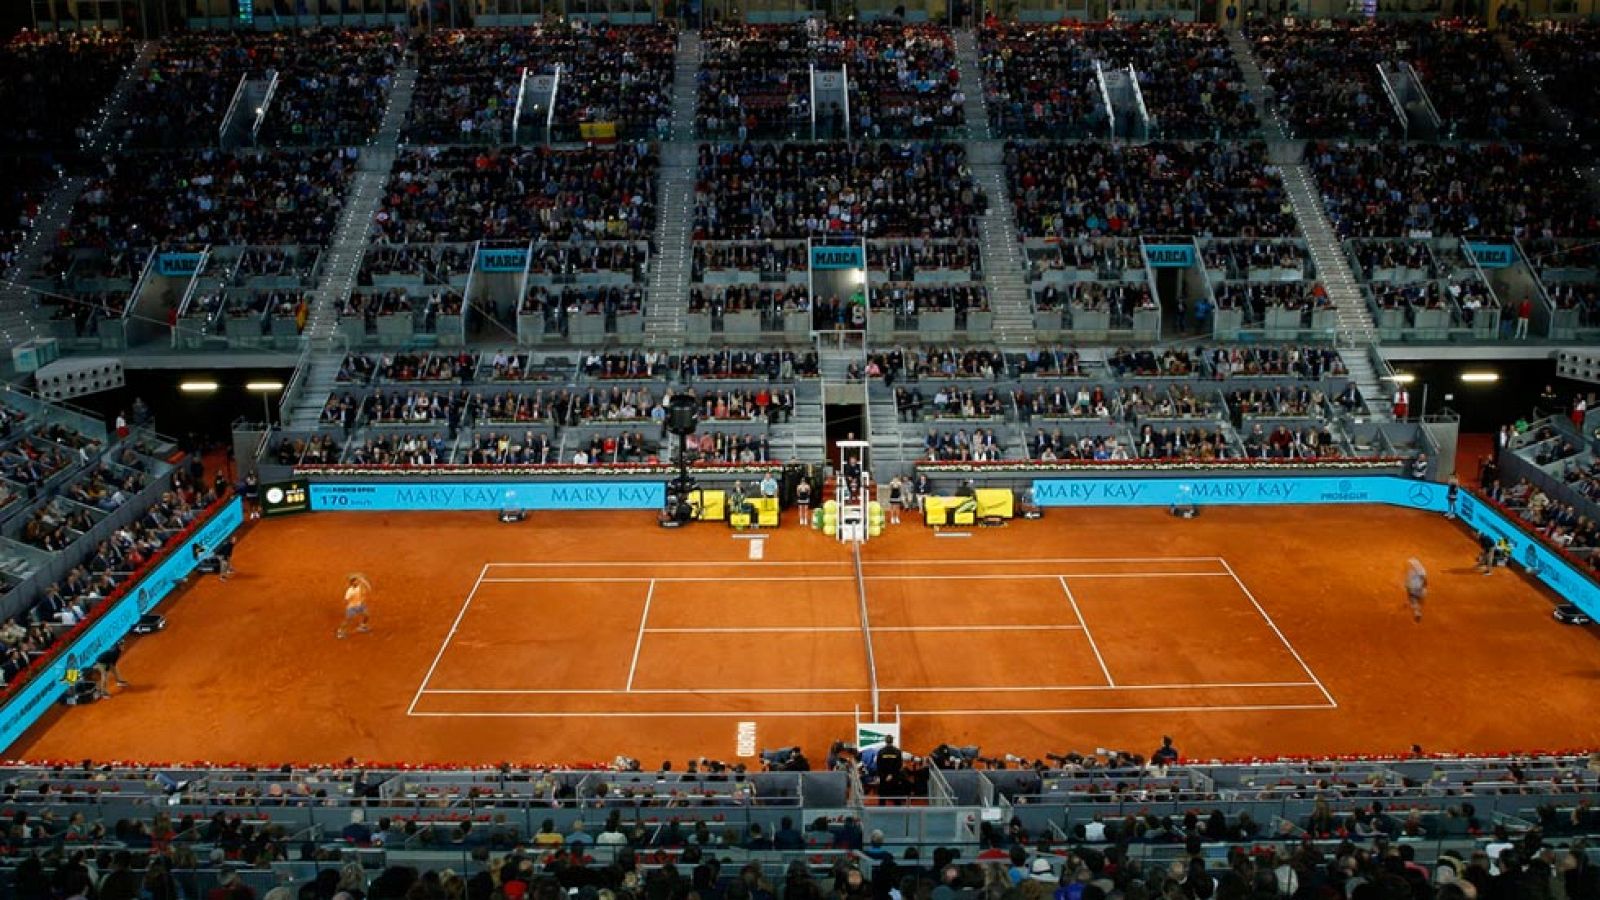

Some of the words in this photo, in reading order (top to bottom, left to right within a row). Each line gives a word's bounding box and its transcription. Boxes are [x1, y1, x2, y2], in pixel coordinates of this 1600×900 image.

[163, 259, 200, 271] MARC
[815, 252, 858, 265] MARCA
[396, 488, 456, 503] MARY
[463, 488, 500, 503] KAY
[552, 487, 610, 503] MARY
[618, 487, 657, 502] KAY
[1036, 483, 1096, 500] MARY
[1103, 483, 1142, 499] KAY
[1191, 482, 1250, 499] MARY
[1258, 482, 1296, 498] KAY
[321, 495, 349, 506] 170
